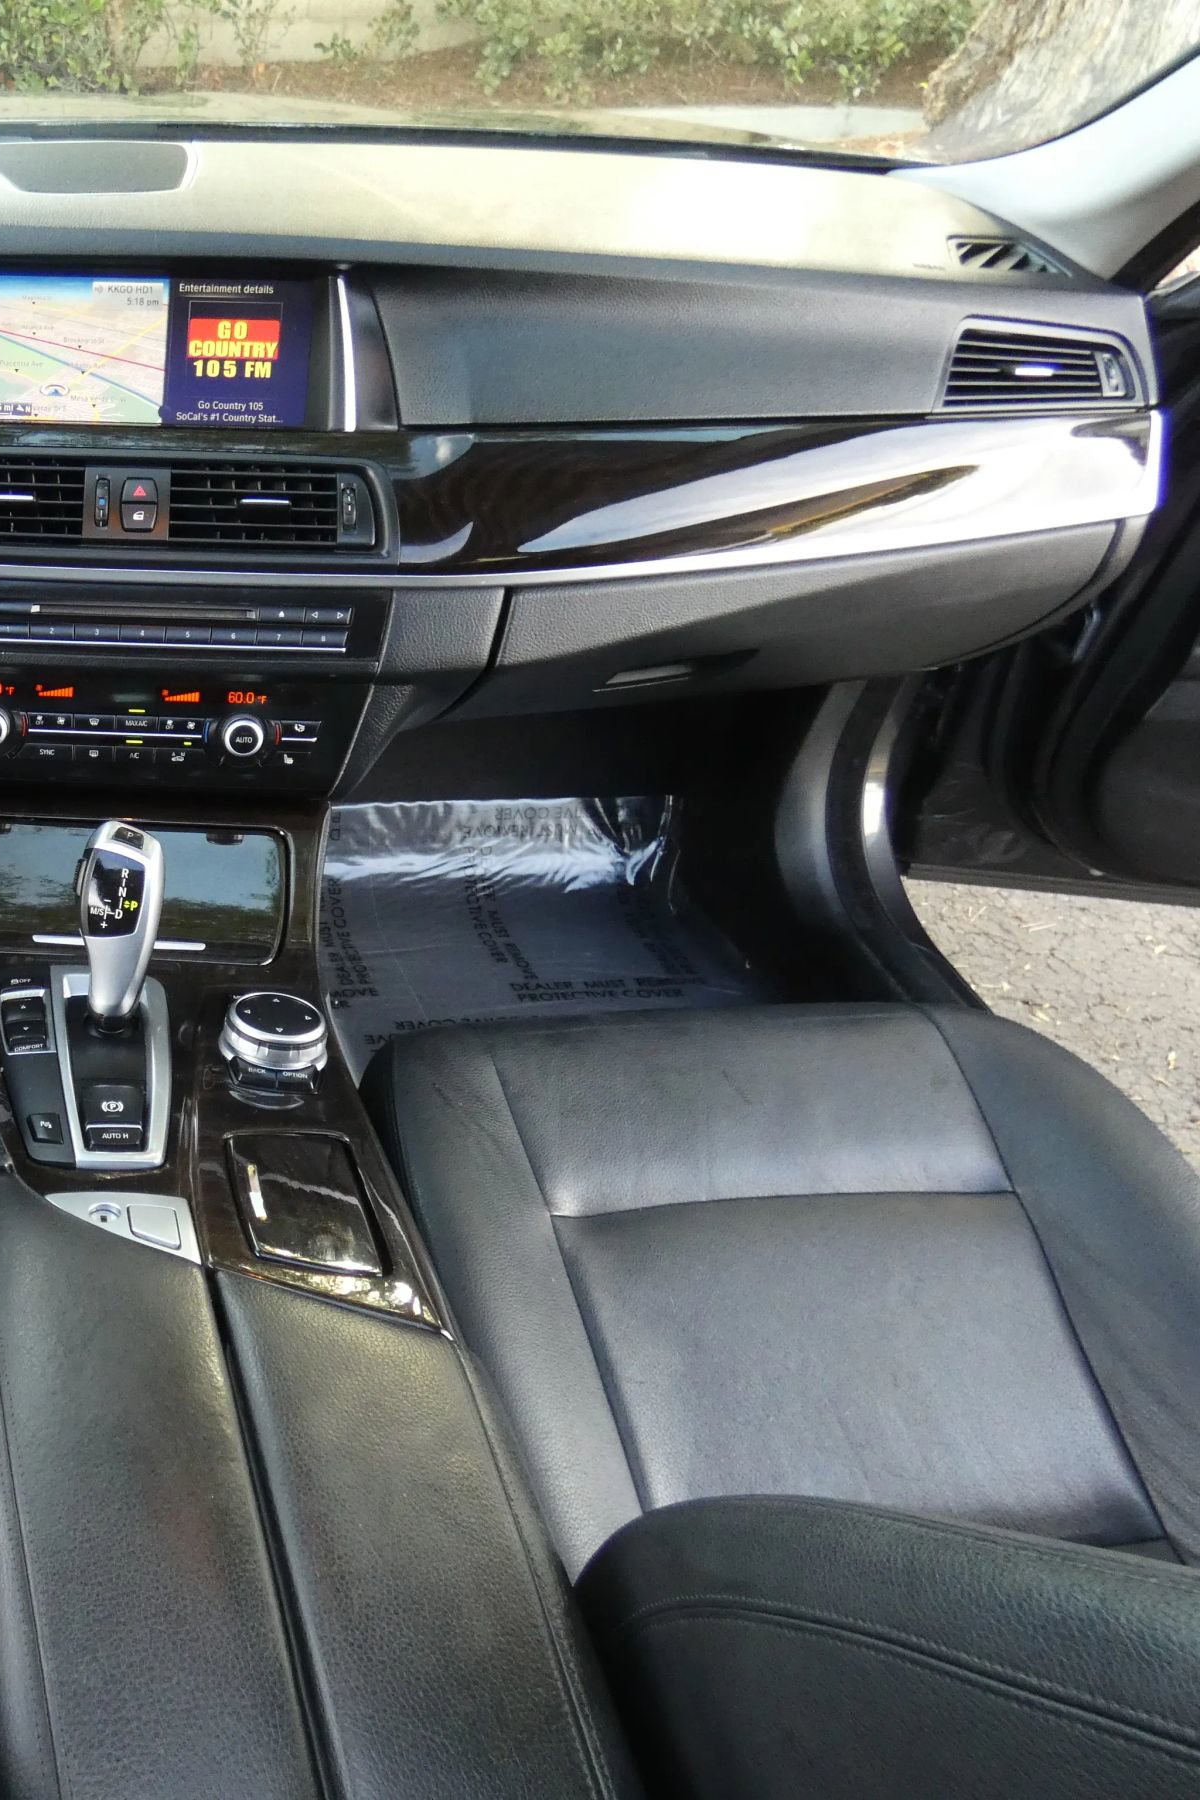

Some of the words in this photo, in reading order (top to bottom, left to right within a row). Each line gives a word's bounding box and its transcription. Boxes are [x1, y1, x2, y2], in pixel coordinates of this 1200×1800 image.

[107, 285, 132, 295] KKGO
[136, 285, 153, 295] HD1
[179, 283, 241, 294] Entertainment
[244, 284, 274, 294] details
[127, 297, 144, 306] 5:18
[147, 299, 159, 308] pm
[218, 320, 247, 340] GO
[189, 340, 278, 359] COUNTRY
[193, 360, 237, 378] 105
[244, 361, 272, 379] FM
[197, 400, 210, 410] Go
[212, 401, 246, 412] Country
[250, 402, 264, 411] 105
[176, 412, 208, 421] SoCal's
[210, 413, 220, 421] #1
[222, 414, 256, 424] Country
[228, 691, 255, 704] 60.0
[122, 868, 129, 879] R
[118, 886, 127, 897] N
[130, 900, 138, 911] P
[328, 879, 346, 928] COVER
[90, 906, 104, 916] M/S
[115, 908, 123, 919] D
[14, 1043, 44, 1052] COMFORT
[282, 1071, 308, 1079] OPTION
